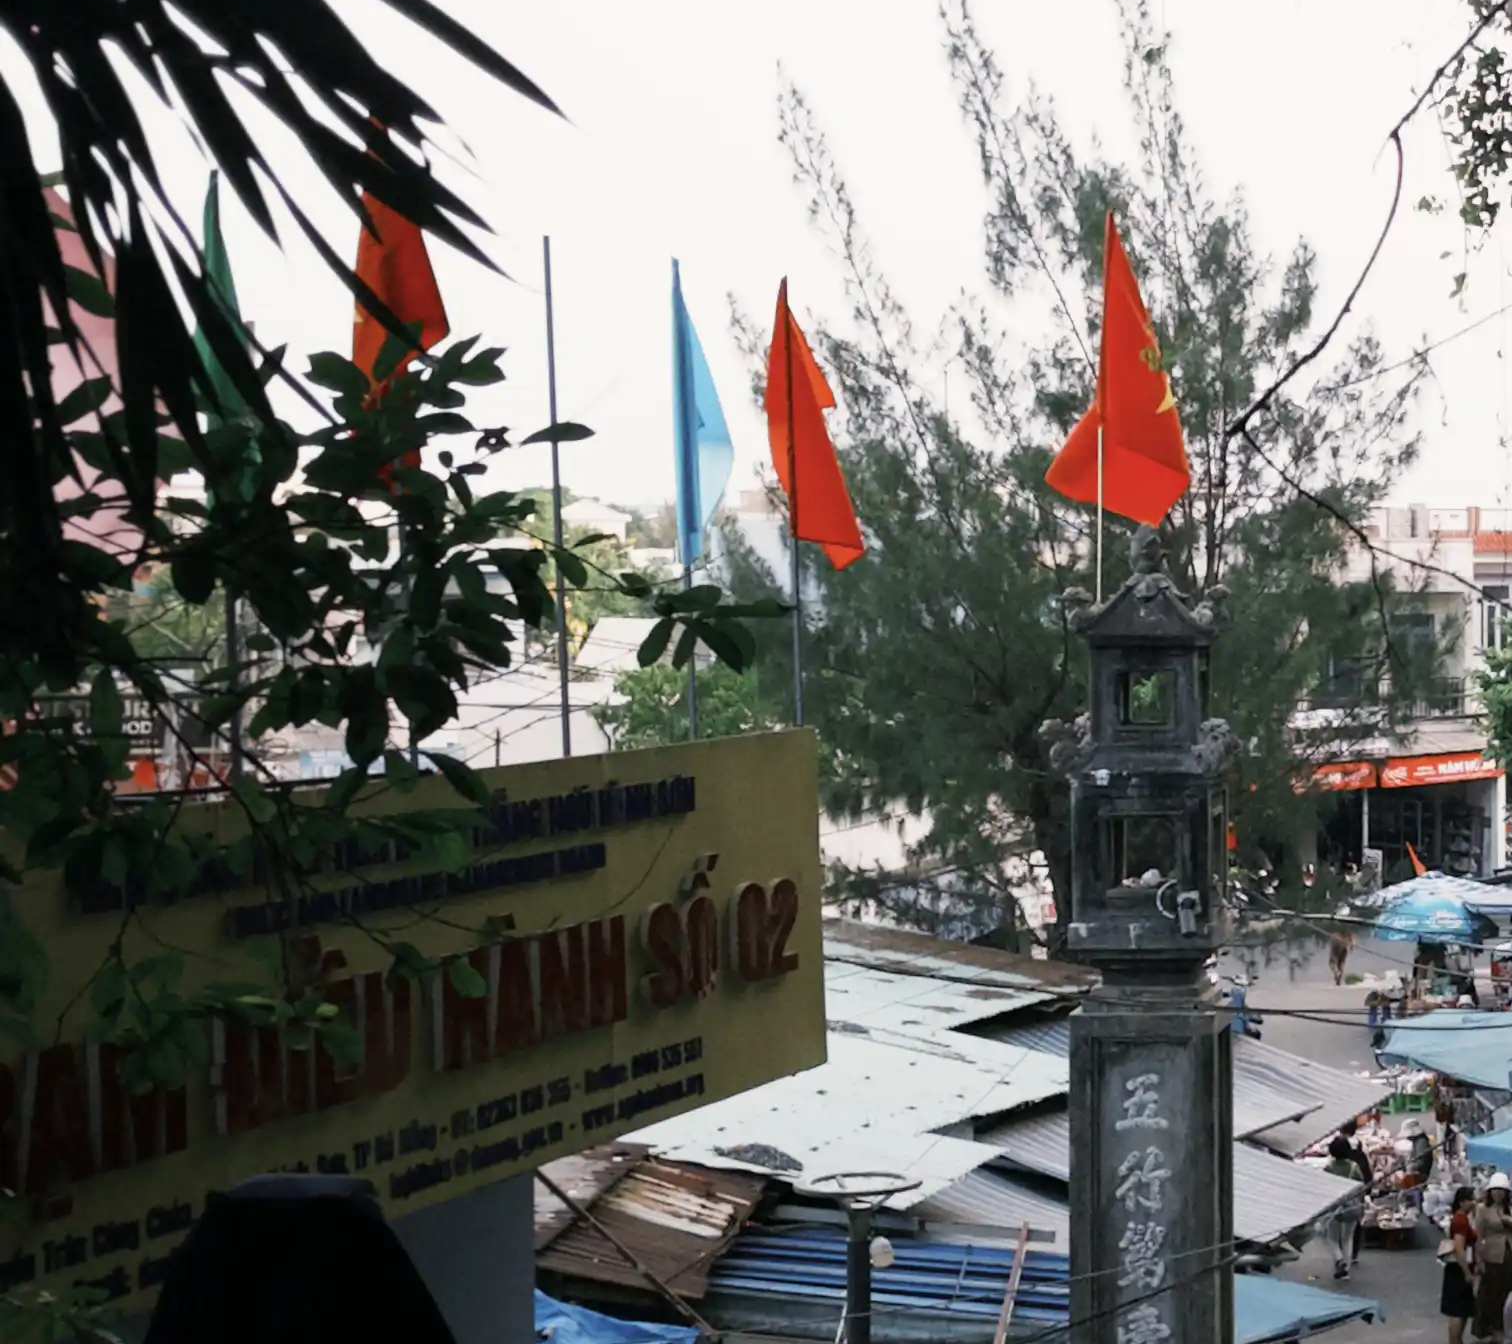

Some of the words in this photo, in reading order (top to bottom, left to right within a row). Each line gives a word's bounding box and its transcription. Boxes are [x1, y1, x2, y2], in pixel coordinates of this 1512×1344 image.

[599, 779, 651, 823] HÀNH
[211, 935, 412, 1136] ĐIỀU
[433, 913, 628, 1073] HÀNH
[641, 853, 718, 1008] SỐ
[730, 878, 799, 983] 02
